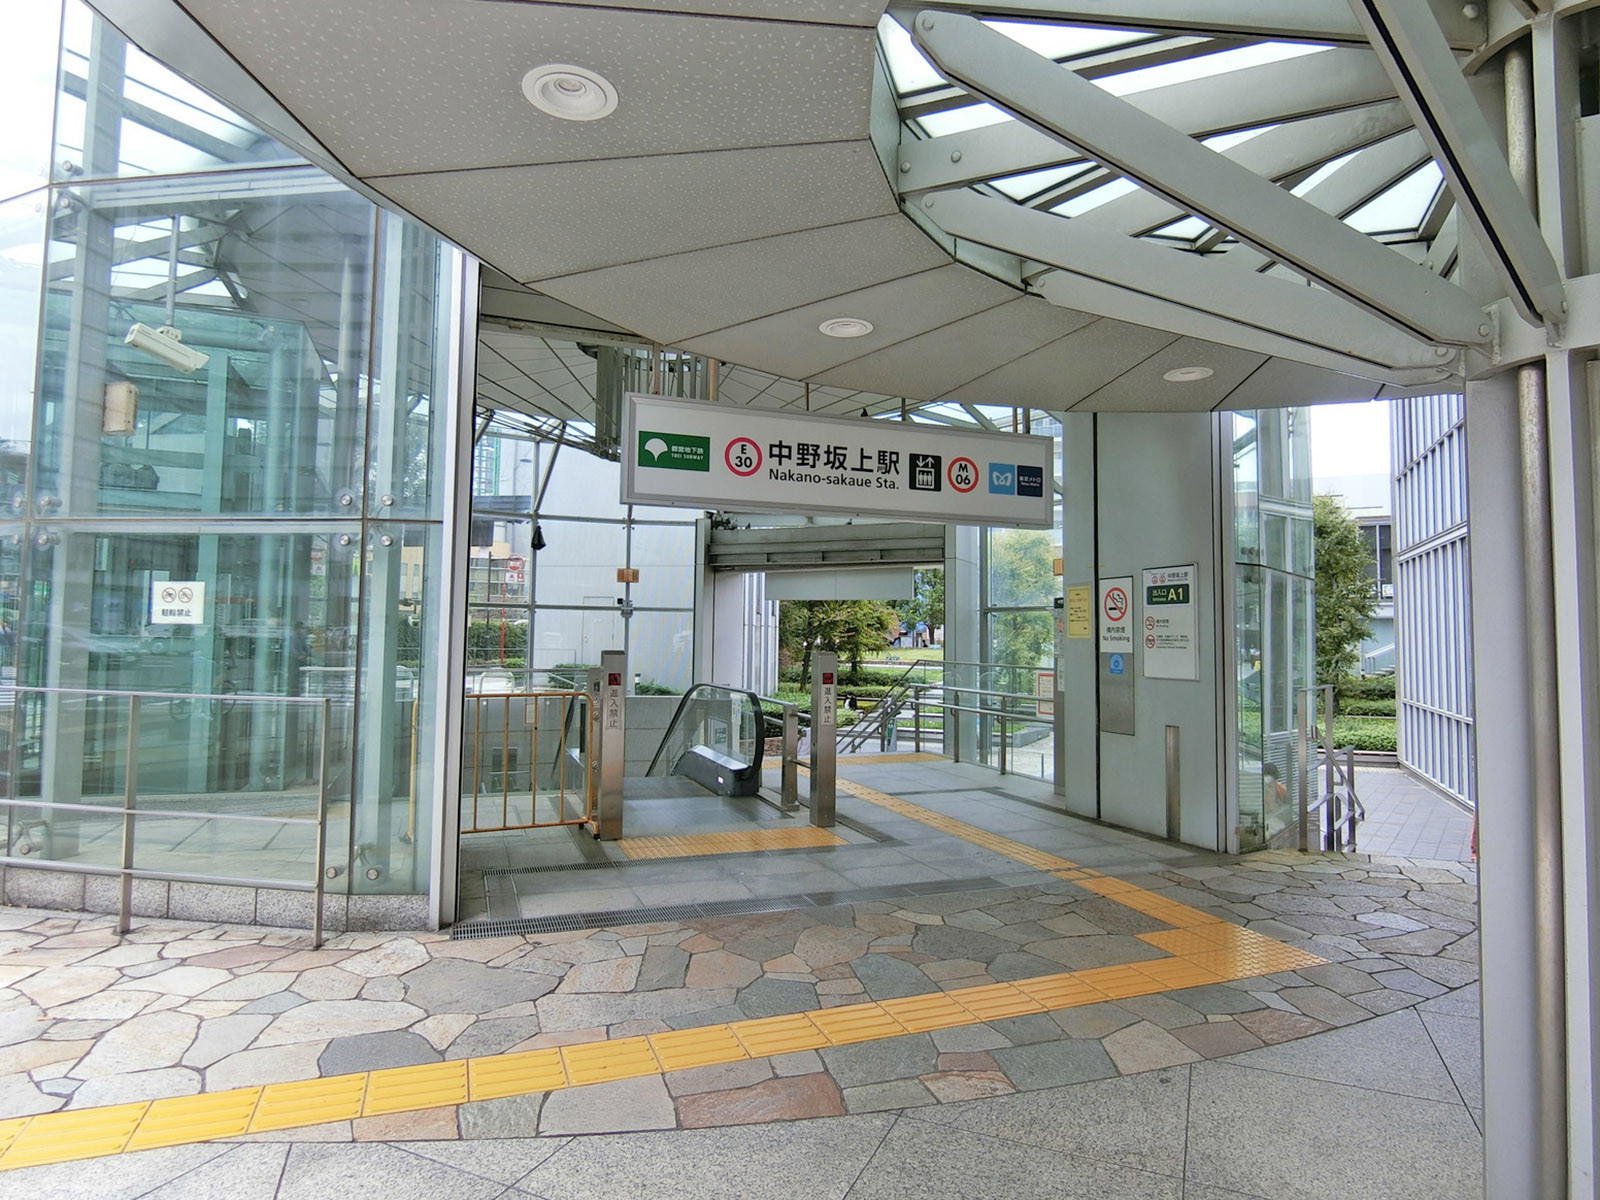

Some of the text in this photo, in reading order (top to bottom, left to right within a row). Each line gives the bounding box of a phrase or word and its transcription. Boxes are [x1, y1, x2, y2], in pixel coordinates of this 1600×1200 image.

[740, 444, 747, 455] E
[734, 456, 753, 468] 30
[769, 440, 900, 475] 中野坂上駅
[958, 463, 968, 473] M
[769, 468, 899, 490] Nakano-sakaue Sta.
[955, 474, 971, 485] 06
[1167, 587, 1184, 601] A1
[1109, 635, 1131, 643] Smoking
